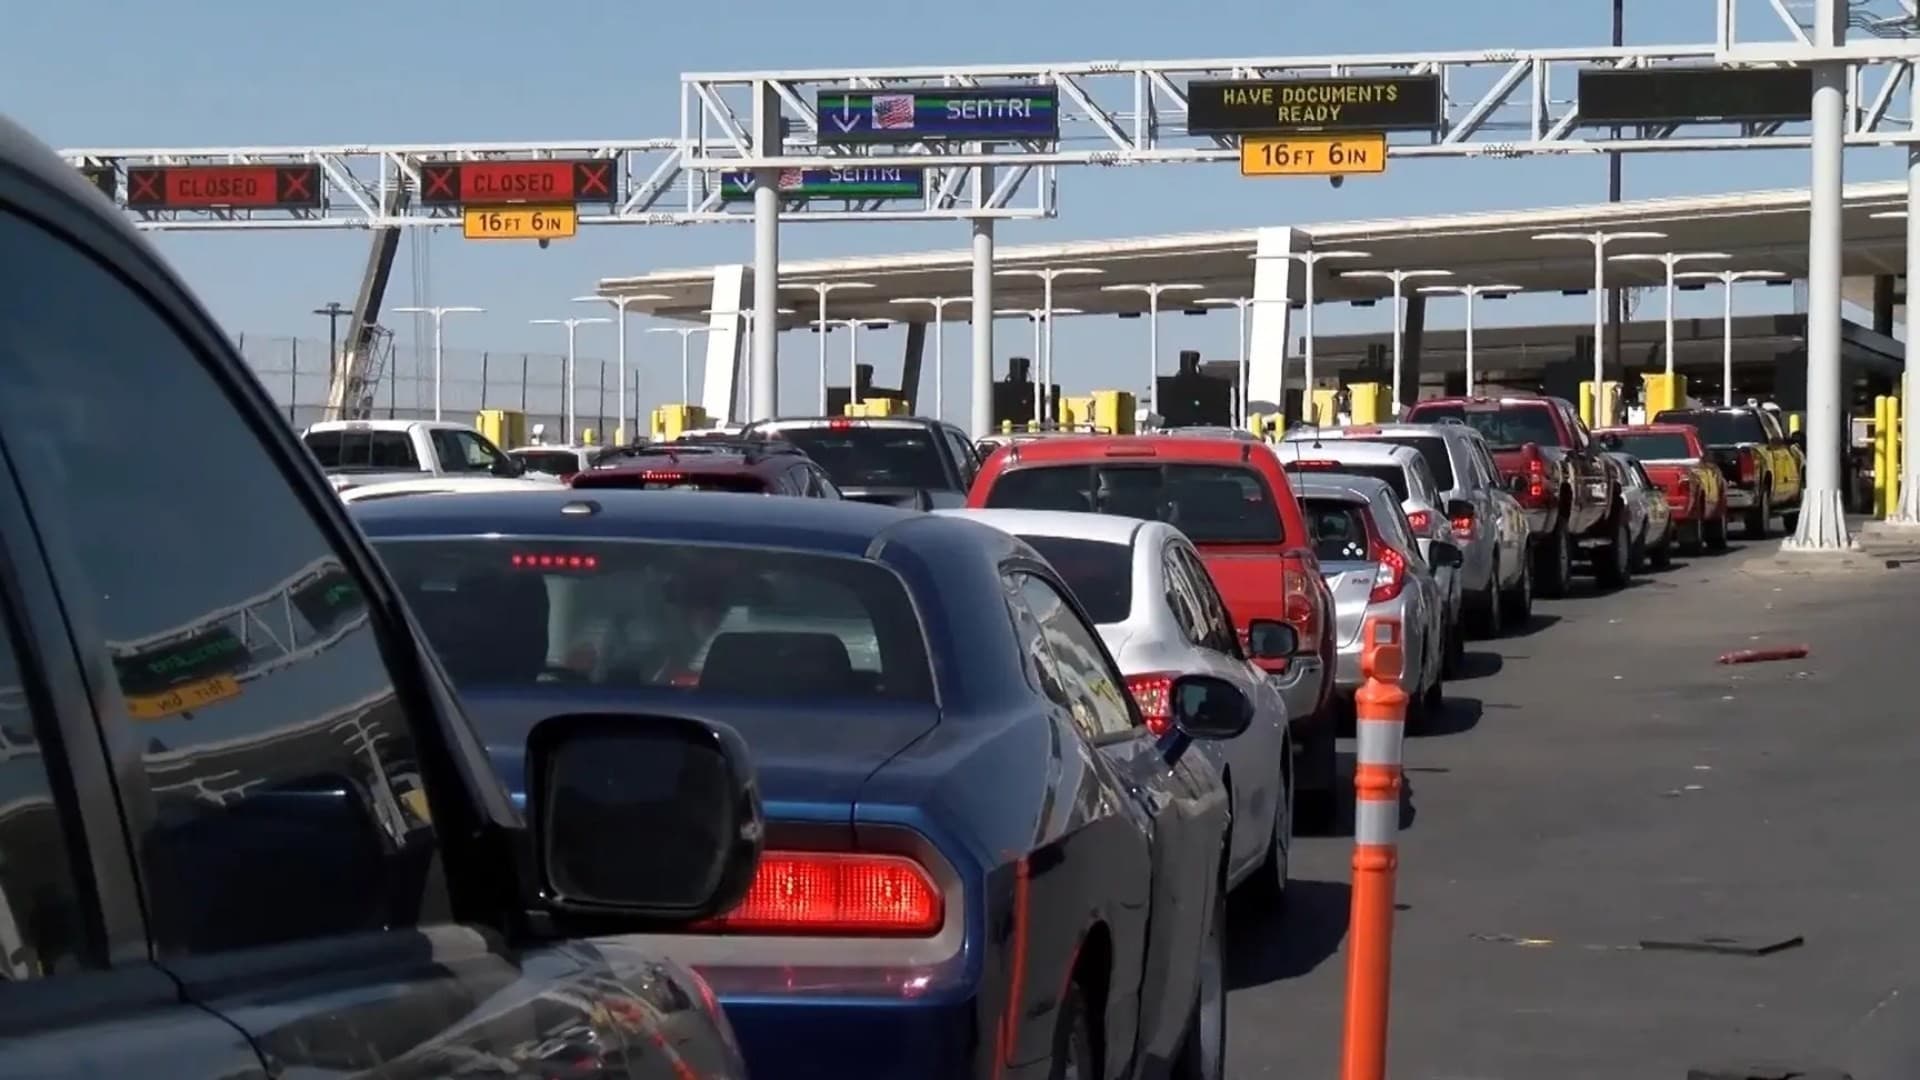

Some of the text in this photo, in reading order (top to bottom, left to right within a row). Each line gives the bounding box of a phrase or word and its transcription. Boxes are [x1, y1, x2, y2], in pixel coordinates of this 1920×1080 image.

[1223, 84, 1398, 105] HAVE DOCUMENTS
[946, 97, 1032, 120] SENTRI
[1278, 104, 1342, 122] READY
[179, 177, 258, 197] CLOSED
[473, 173, 555, 193] CLOSED
